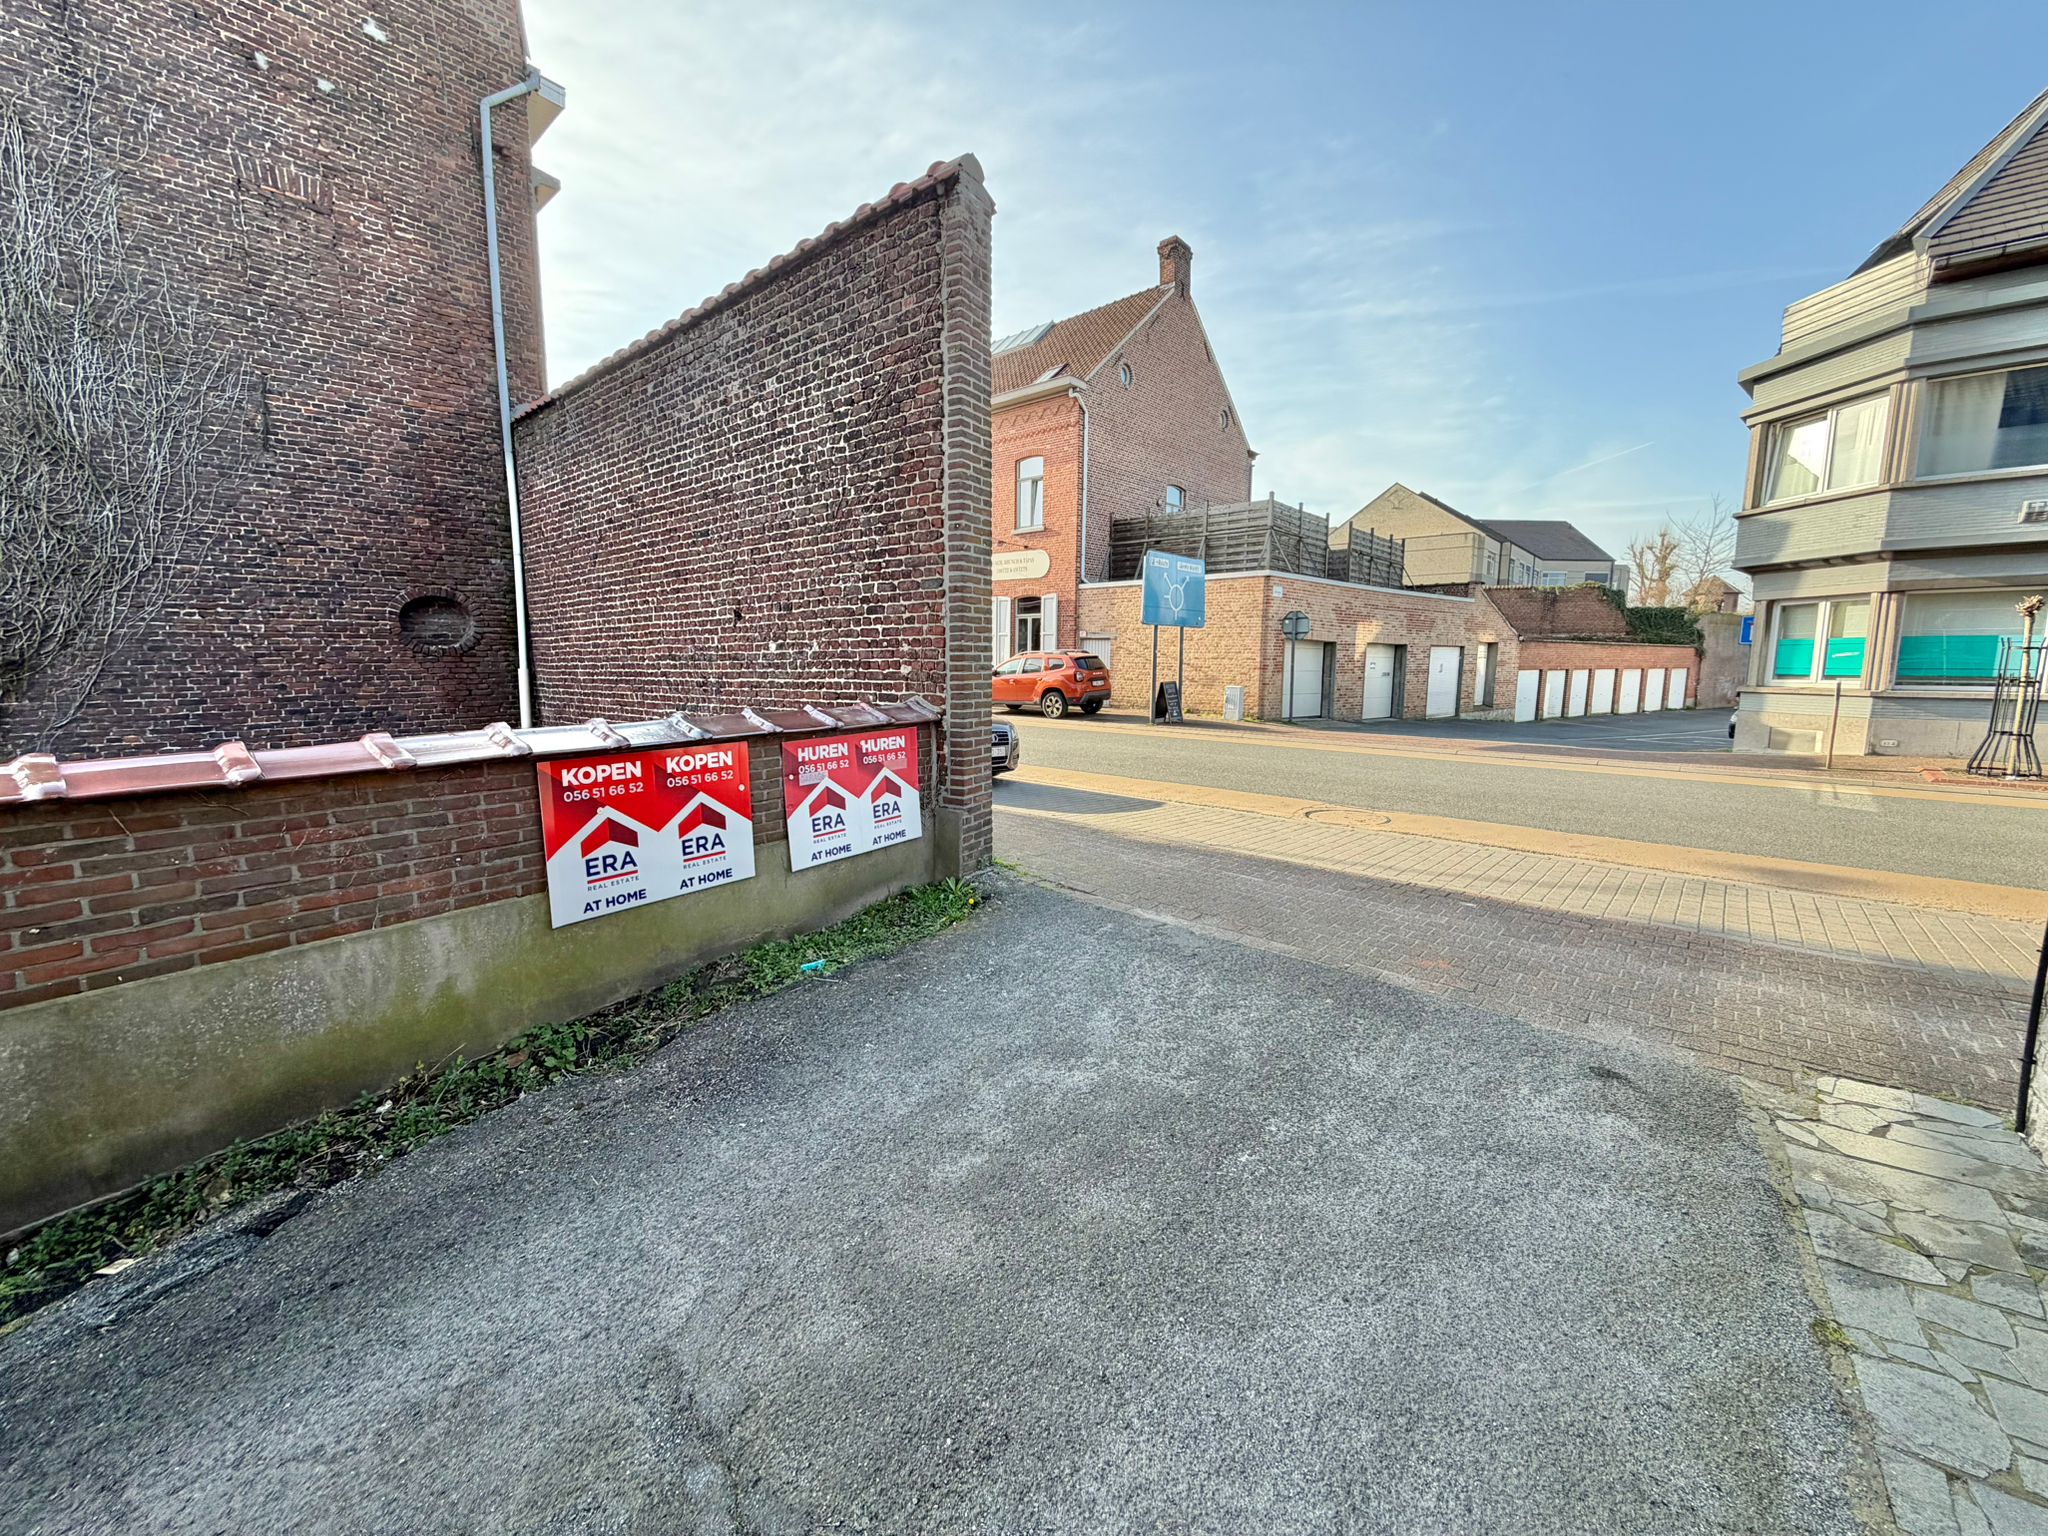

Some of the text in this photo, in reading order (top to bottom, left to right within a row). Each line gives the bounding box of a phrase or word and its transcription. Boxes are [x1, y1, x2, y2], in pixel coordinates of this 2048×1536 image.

[797, 742, 849, 762] HUREN
[861, 735, 905, 753] HUREN
[666, 750, 734, 774] KOPEN
[798, 759, 849, 774] 056 51 66 52
[863, 755, 877, 764] 056
[877, 754, 886, 762] 51
[886, 752, 896, 760] 66
[897, 751, 906, 759] 52
[561, 761, 643, 787] KOPEN
[666, 770, 734, 788] 056 51 66 52
[563, 782, 644, 803] 056 51 66 52
[872, 800, 901, 819] ERA
[811, 813, 846, 833] ERA
[682, 832, 726, 857] ERA
[872, 829, 907, 846] AT HOME
[811, 843, 852, 862] AT HOME
[585, 850, 639, 878] ERA
[683, 855, 727, 870] REAL ESTATE
[587, 875, 640, 893] REAL ESTATE
[679, 868, 734, 890] AT HOME
[583, 889, 648, 915] AT HOME
